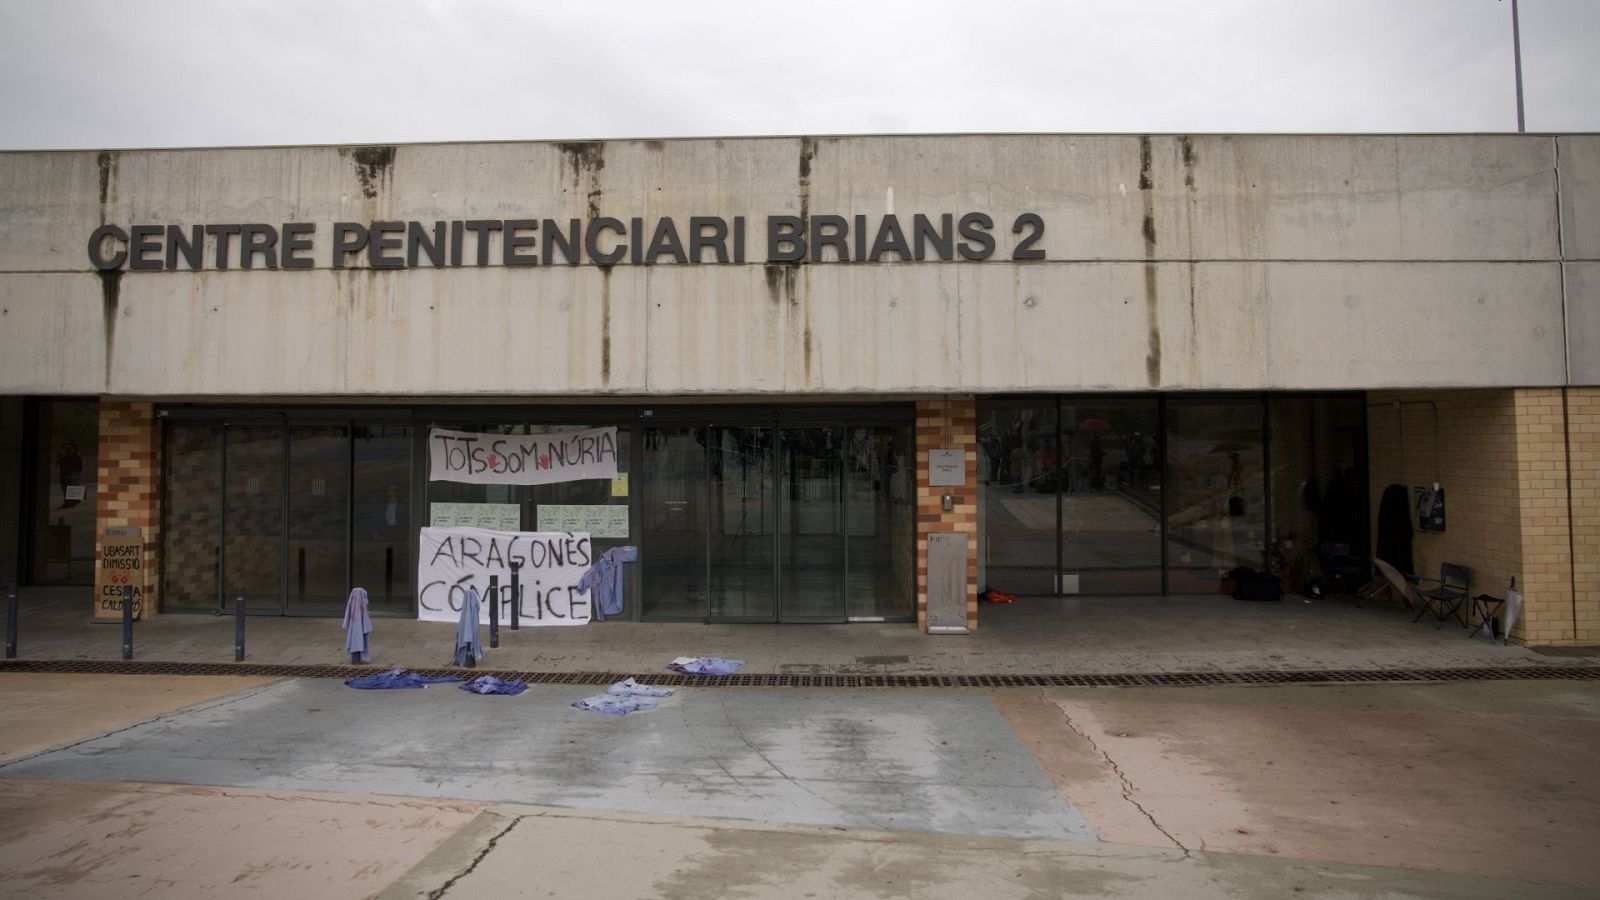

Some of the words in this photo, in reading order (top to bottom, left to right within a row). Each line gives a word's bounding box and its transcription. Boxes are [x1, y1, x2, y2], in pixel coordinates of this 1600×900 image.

[88, 222, 315, 271] CENTRE
[333, 215, 746, 269] PENITENCIARI
[767, 212, 996, 263] BRIANS
[1012, 213, 1046, 261] 2
[549, 432, 617, 468] NÚRIA
[103, 545, 140, 557] UBASART
[430, 532, 590, 569] ARAGONÈS
[103, 585, 141, 597] CESA
